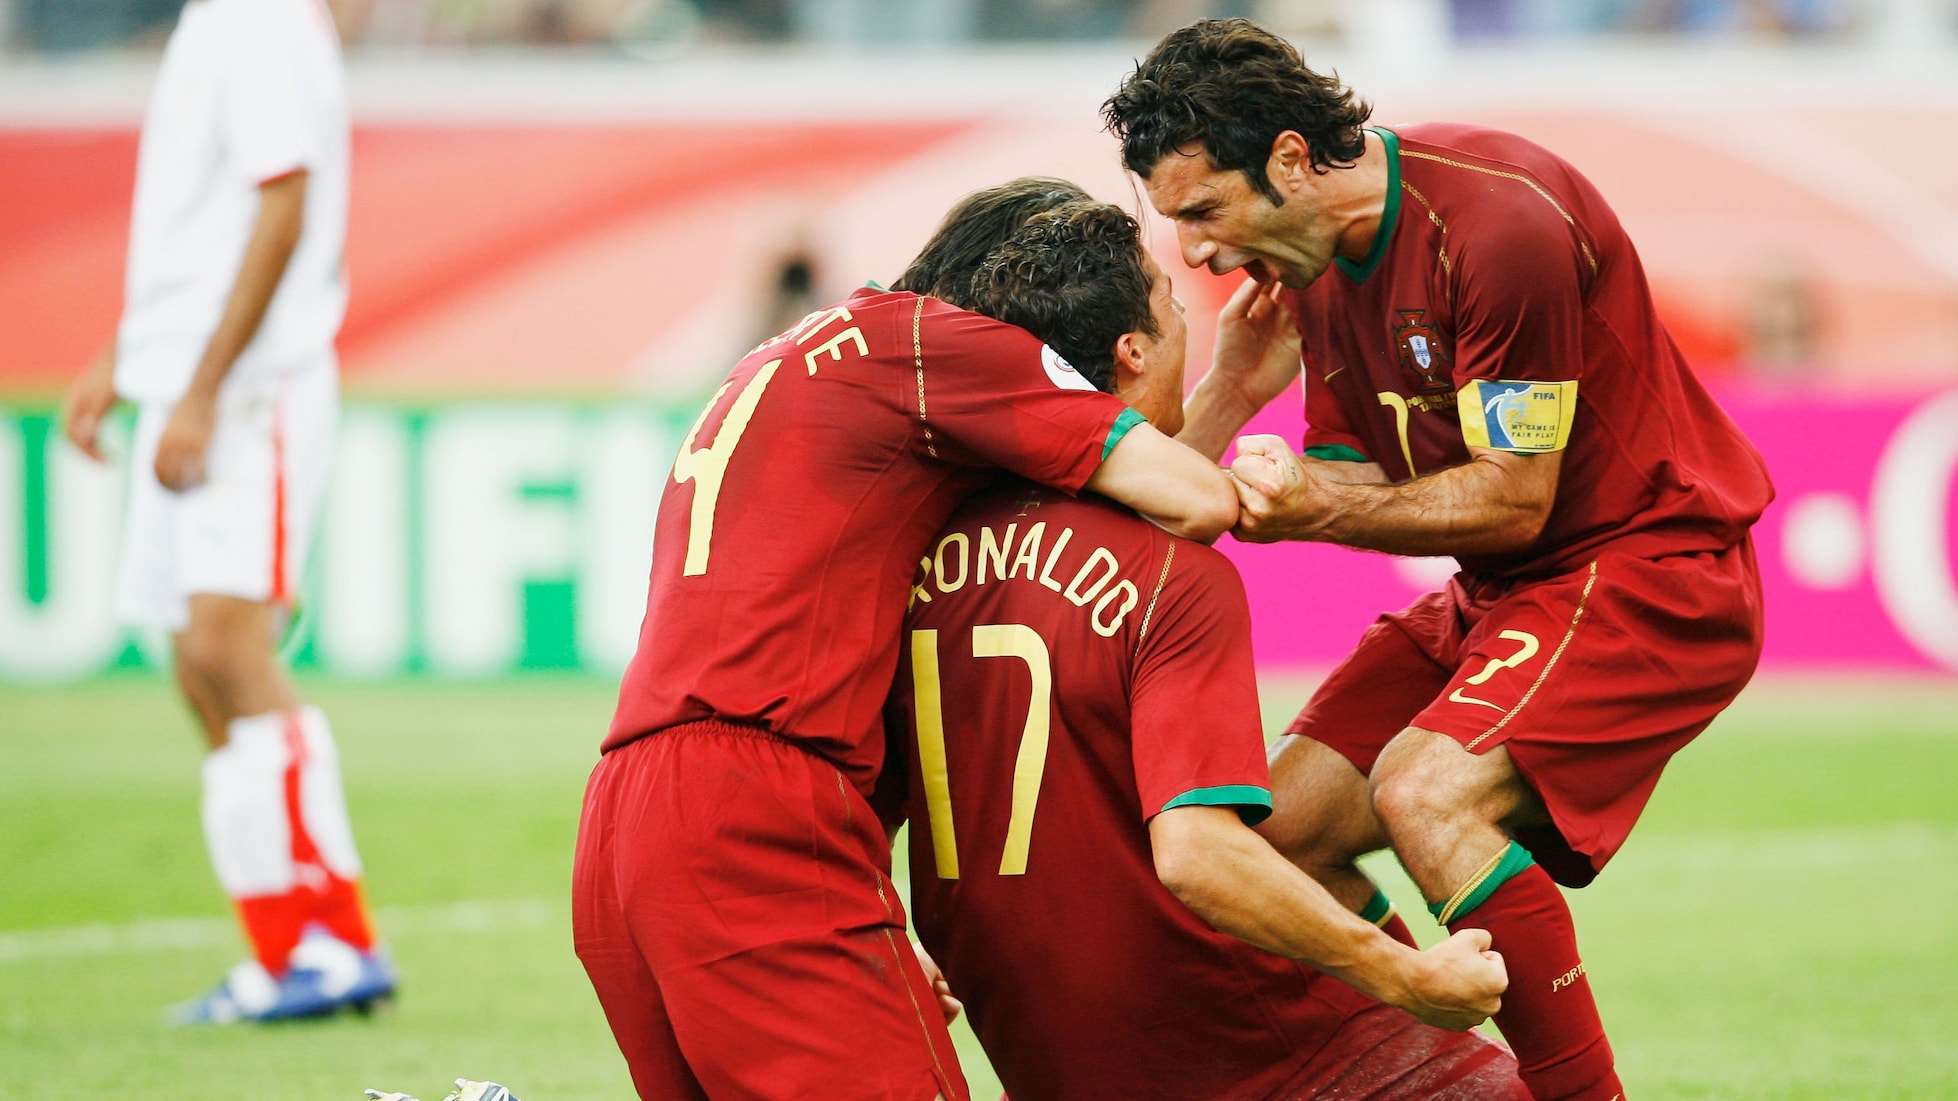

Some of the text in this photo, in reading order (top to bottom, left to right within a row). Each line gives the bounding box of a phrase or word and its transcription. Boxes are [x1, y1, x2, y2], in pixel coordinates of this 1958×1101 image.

[1376, 391, 1419, 479] 7
[1533, 392, 1556, 400] FIFA
[674, 359, 783, 577] 4
[907, 521, 1139, 638] RONALDO
[1464, 629, 1540, 686] 7
[911, 623, 1052, 880] 17
